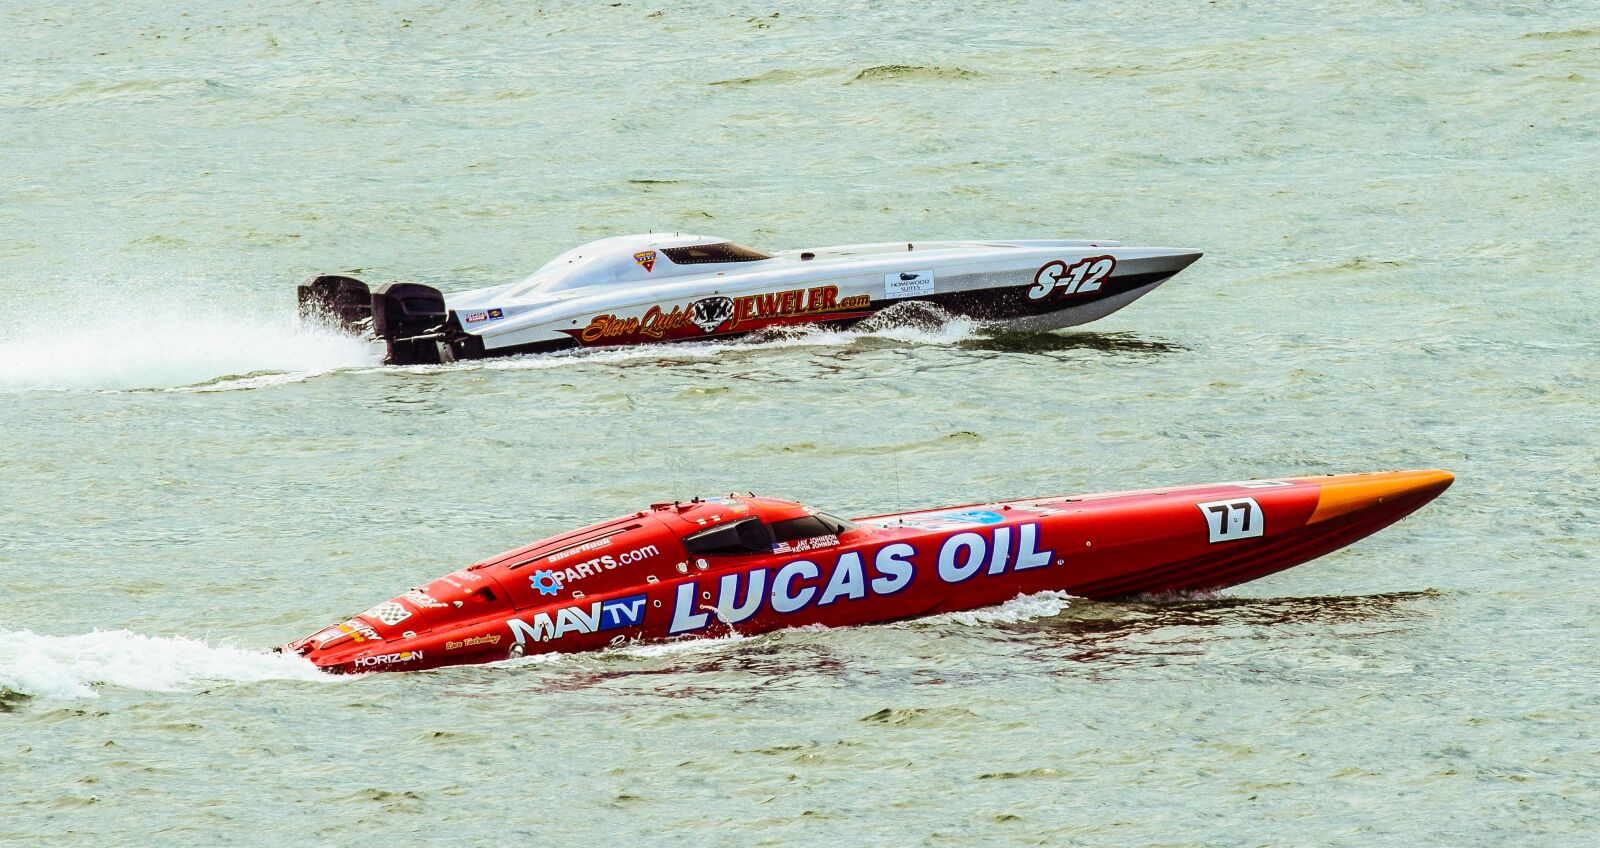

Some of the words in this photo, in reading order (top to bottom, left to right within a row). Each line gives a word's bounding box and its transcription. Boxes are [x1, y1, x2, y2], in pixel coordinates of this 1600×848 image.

[1025, 255, 1116, 303] S-12
[582, 314, 639, 342] Steve
[640, 302, 695, 338] Quick
[1208, 502, 1251, 534] 77
[792, 545, 811, 553] KEVIN
[812, 540, 840, 549] JOHNSON
[810, 534, 837, 543] JOHNSON
[551, 544, 660, 586] PARTS.com
[668, 541, 918, 635] LUCAS
[936, 521, 1056, 584] OIL
[354, 650, 424, 667] HORIZON
